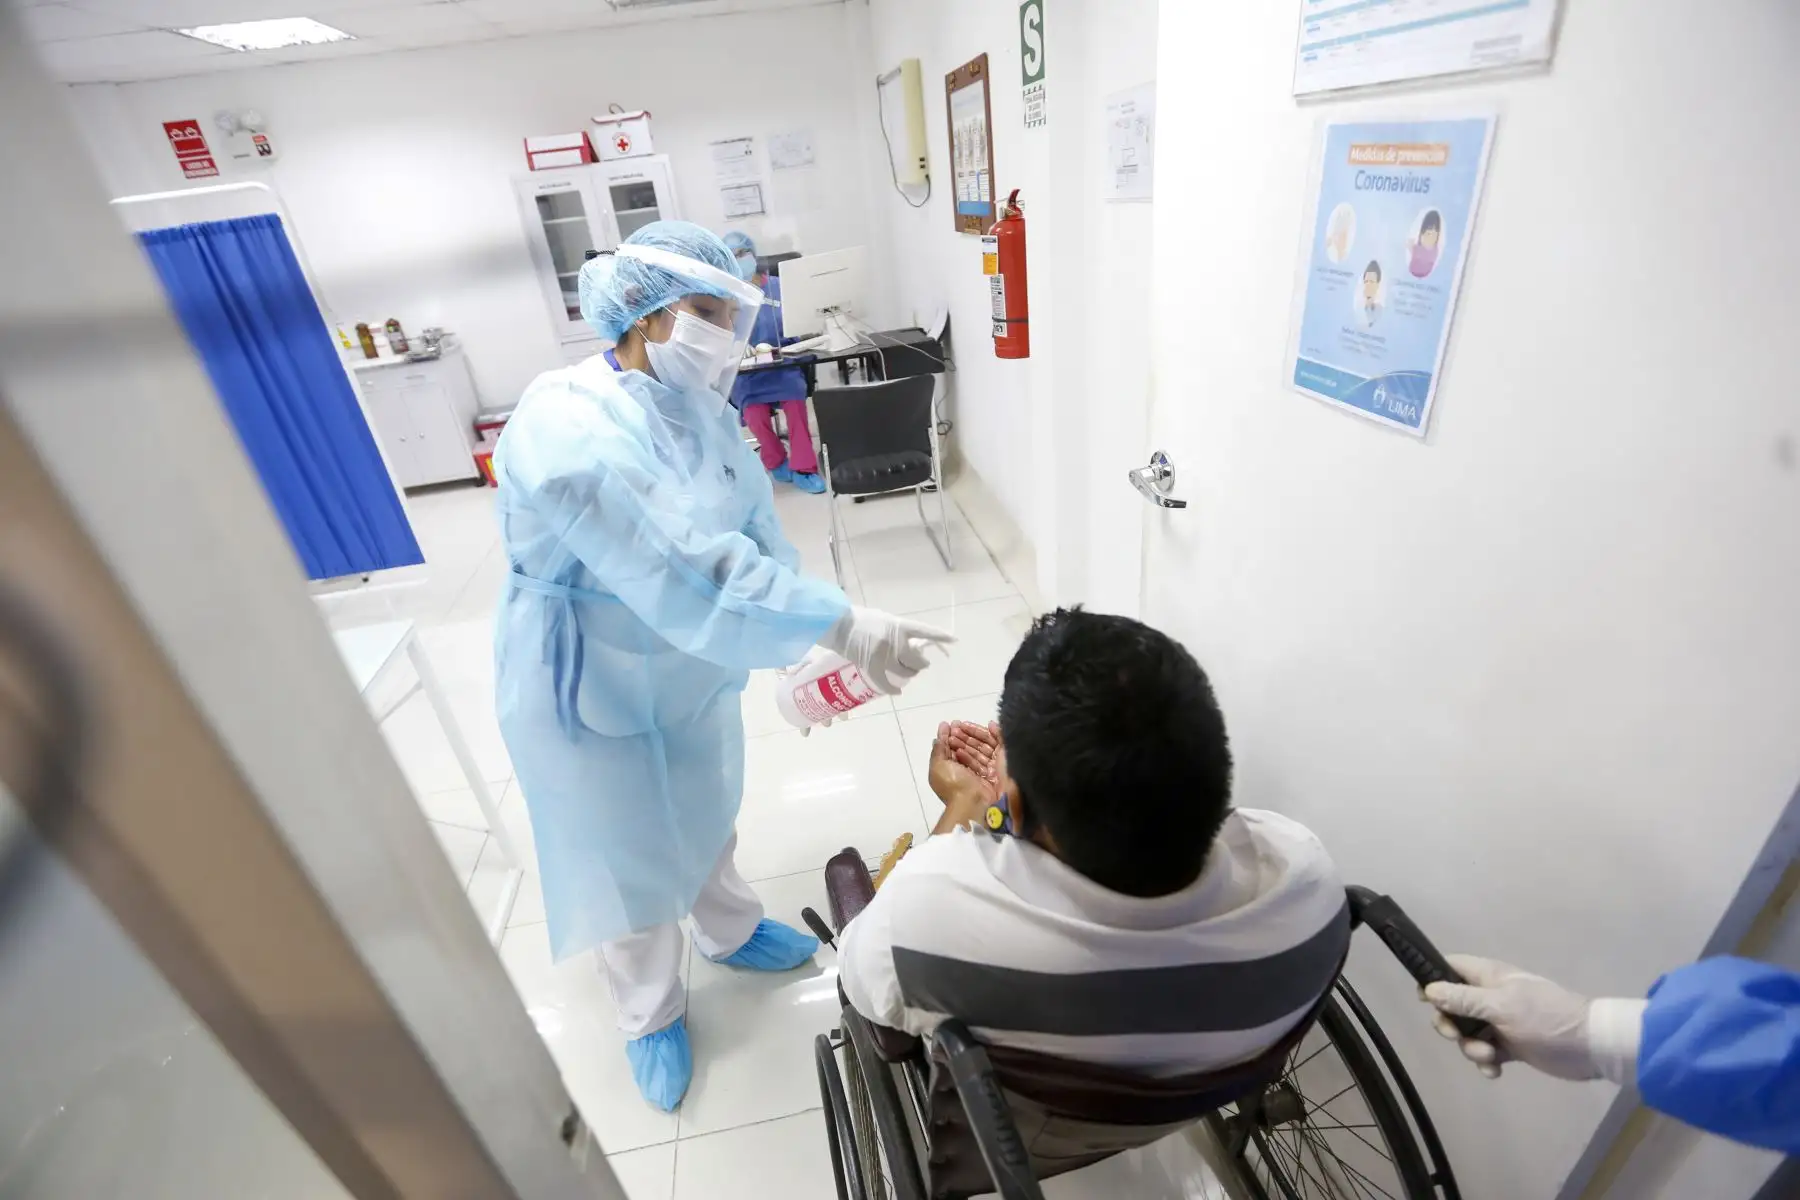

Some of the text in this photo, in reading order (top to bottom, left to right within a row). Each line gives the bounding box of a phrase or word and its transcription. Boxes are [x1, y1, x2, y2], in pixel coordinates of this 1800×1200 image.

[1024, 4, 1042, 77] S
[1385, 146, 1397, 161] de
[1355, 169, 1431, 194] Coronavirus
[1388, 399, 1418, 420] LIMA
